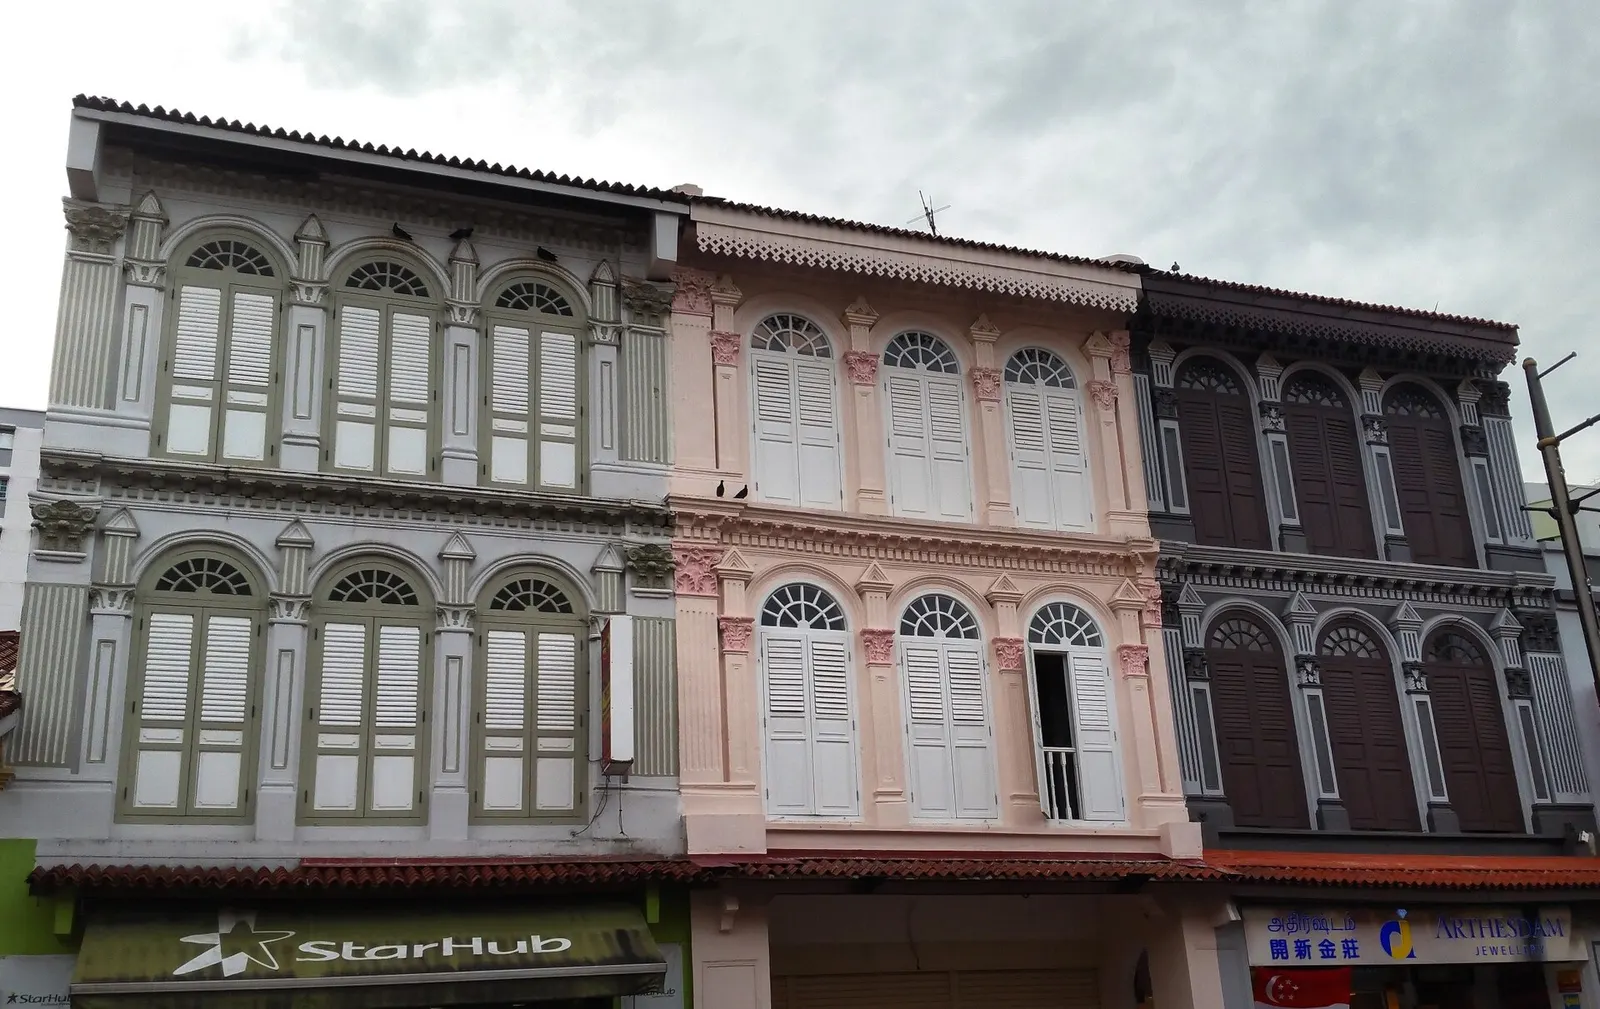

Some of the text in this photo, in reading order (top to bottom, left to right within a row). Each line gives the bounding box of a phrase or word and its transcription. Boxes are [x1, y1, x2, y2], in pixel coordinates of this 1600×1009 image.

[1435, 915, 1564, 939] ARTHESDAM
[296, 934, 572, 961] StarHub
[1475, 945, 1545, 956] JEWELLERY
